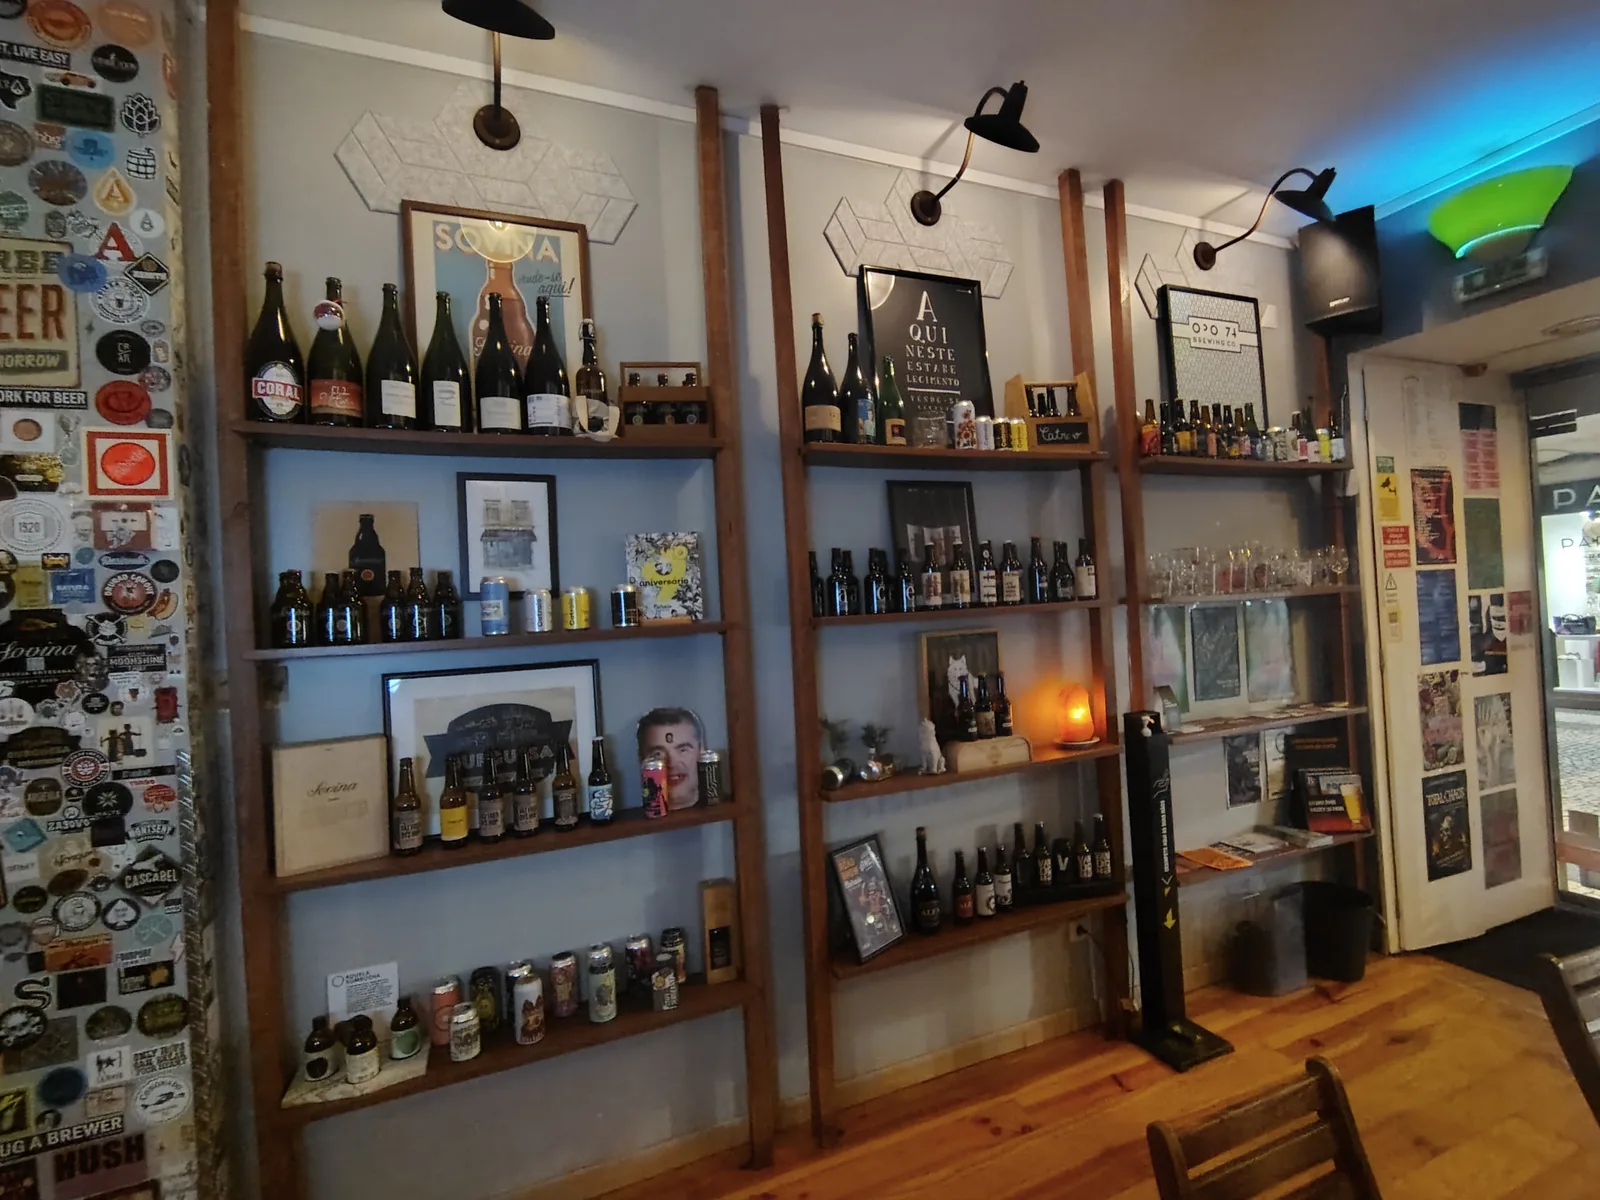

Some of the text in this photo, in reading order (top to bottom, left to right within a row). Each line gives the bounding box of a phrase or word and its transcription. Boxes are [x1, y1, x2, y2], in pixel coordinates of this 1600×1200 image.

[13, 45, 39, 60] LIVE
[40, 49, 68, 64] EASY
[537, 277, 575, 297] aqui!
[916, 290, 938, 322] A
[909, 323, 948, 344] QUI
[1192, 336, 1225, 346] BREWING
[1225, 326, 1237, 338] 74
[905, 344, 955, 361] NESTE
[906, 374, 960, 387] LECIMENTO
[24, 391, 51, 404] FOR
[53, 391, 86, 405] BEER
[257, 381, 300, 400] CORAL
[639, 577, 689, 588] aniversário
[124, 868, 178, 889] CASCABEL
[29, 1135, 43, 1151] A
[47, 1117, 123, 1144] BREWER
